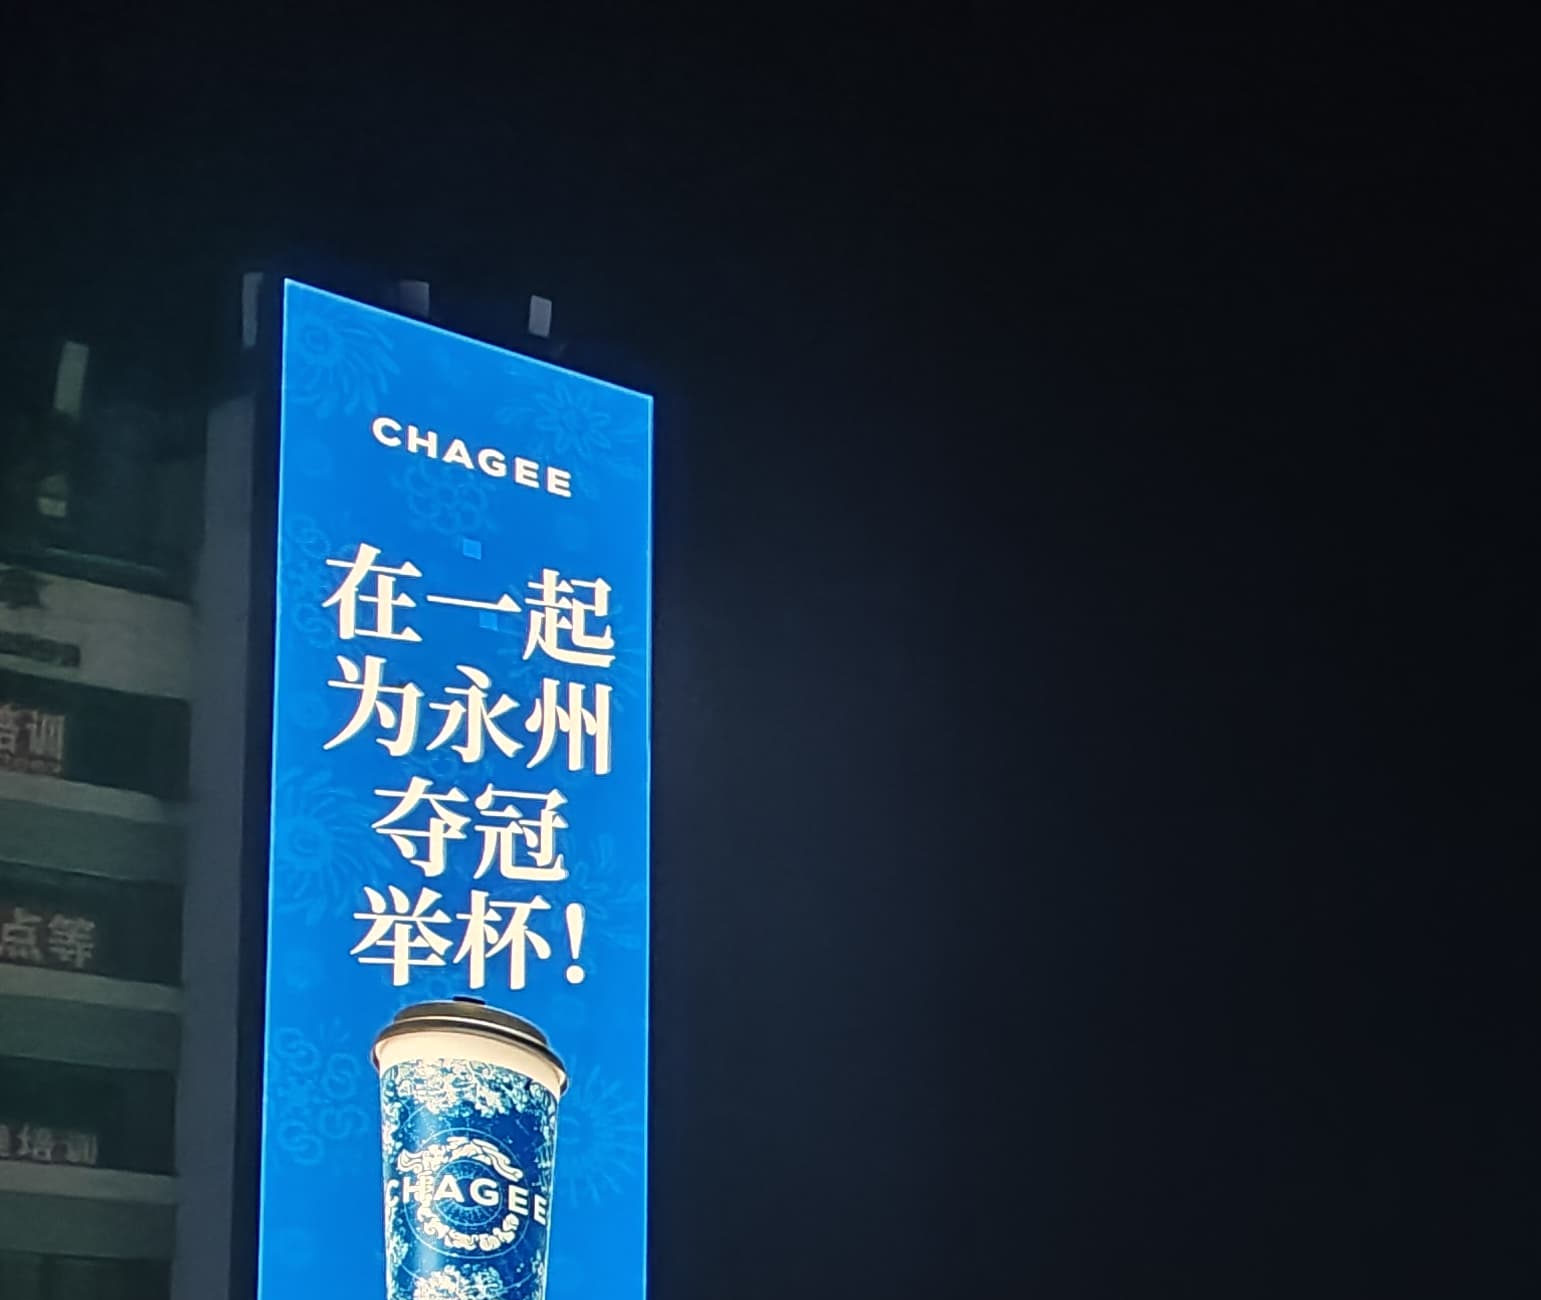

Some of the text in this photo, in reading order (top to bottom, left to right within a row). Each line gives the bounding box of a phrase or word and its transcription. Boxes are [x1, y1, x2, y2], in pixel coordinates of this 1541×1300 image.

[371, 416, 573, 498] CHAGEE
[322, 542, 617, 669] 在一起
[322, 655, 612, 776] 为永州
[370, 776, 568, 882] 夺冠
[350, 884, 587, 991] 举杯!
[385, 1173, 548, 1227] CHAGEE
